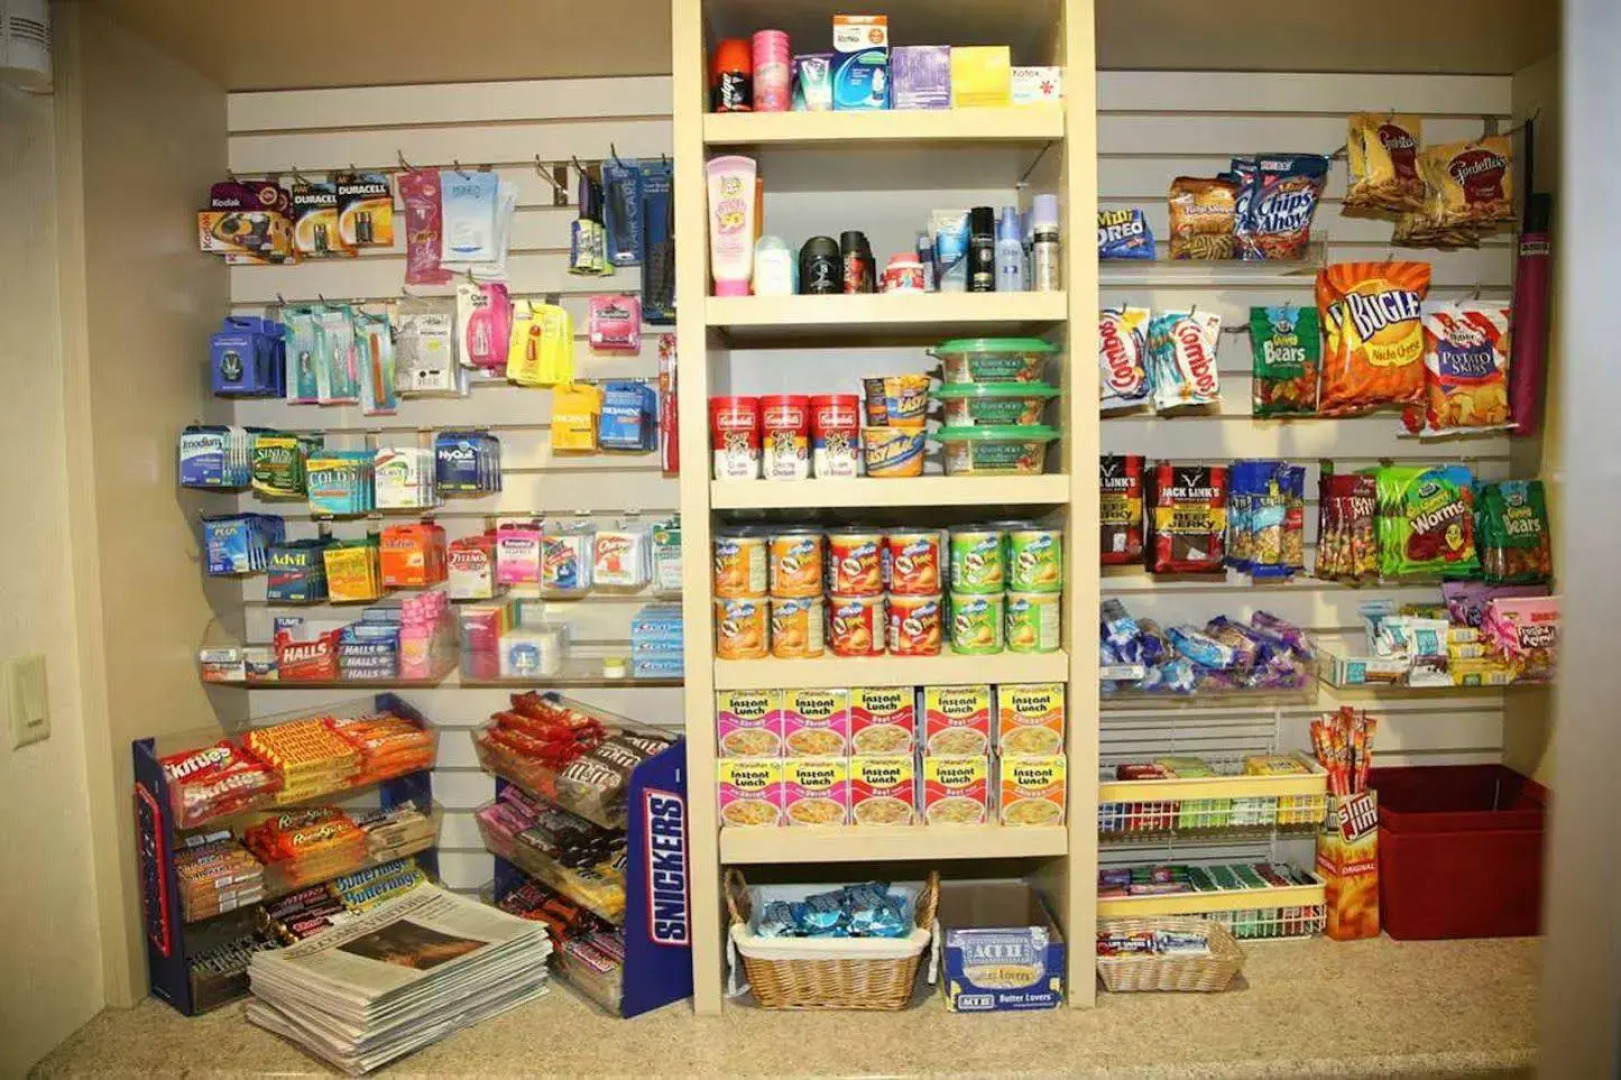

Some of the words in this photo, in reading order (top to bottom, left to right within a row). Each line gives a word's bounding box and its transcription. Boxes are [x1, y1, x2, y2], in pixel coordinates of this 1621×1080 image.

[338, 184, 387, 195] DURACELL
[211, 198, 240, 207] Kodak
[294, 195, 337, 204] DURACEL
[1256, 192, 1313, 217] Chips
[1257, 212, 1309, 234] Ahoy!
[1263, 339, 1306, 364] Bears
[1178, 322, 1216, 394] Combos
[439, 449, 474, 462] NyQuil
[308, 470, 347, 486] COLD
[1162, 486, 1187, 498] JACK
[1188, 486, 1220, 498] LINK'S
[1410, 500, 1465, 535] Worms
[1502, 514, 1541, 535] Bears
[269, 553, 306, 566] Advil
[283, 642, 328, 665] HALLS
[345, 645, 375, 655] HALLS
[347, 657, 378, 666] HALLS
[349, 669, 379, 678] HALLS
[730, 698, 769, 708] Instant
[795, 698, 835, 708] Instant
[862, 694, 901, 703] Instant
[938, 696, 977, 706] Instant
[1012, 695, 1051, 705] Instant
[734, 706, 765, 716] Lunch
[799, 706, 831, 715] Lunch
[866, 701, 898, 711] Lunch
[942, 704, 973, 714] Lunch
[1016, 703, 1047, 713] Lunch
[731, 770, 769, 779] Instant
[796, 769, 835, 778] Instant
[862, 767, 901, 776] Instant
[936, 767, 975, 776] Instant
[1014, 768, 1053, 777] Instant
[735, 778, 766, 787] Lunch
[800, 777, 831, 786] Lunch
[866, 775, 897, 784] Lunch
[940, 775, 971, 784] Lunch
[1018, 776, 1049, 785] Lunch
[649, 797, 686, 941] SNICKERS
[1341, 862, 1376, 876] ORIGINAL
[974, 944, 1001, 958] ACT
[999, 994, 1024, 1003] Butter
[1025, 993, 1051, 1002] Lovers
